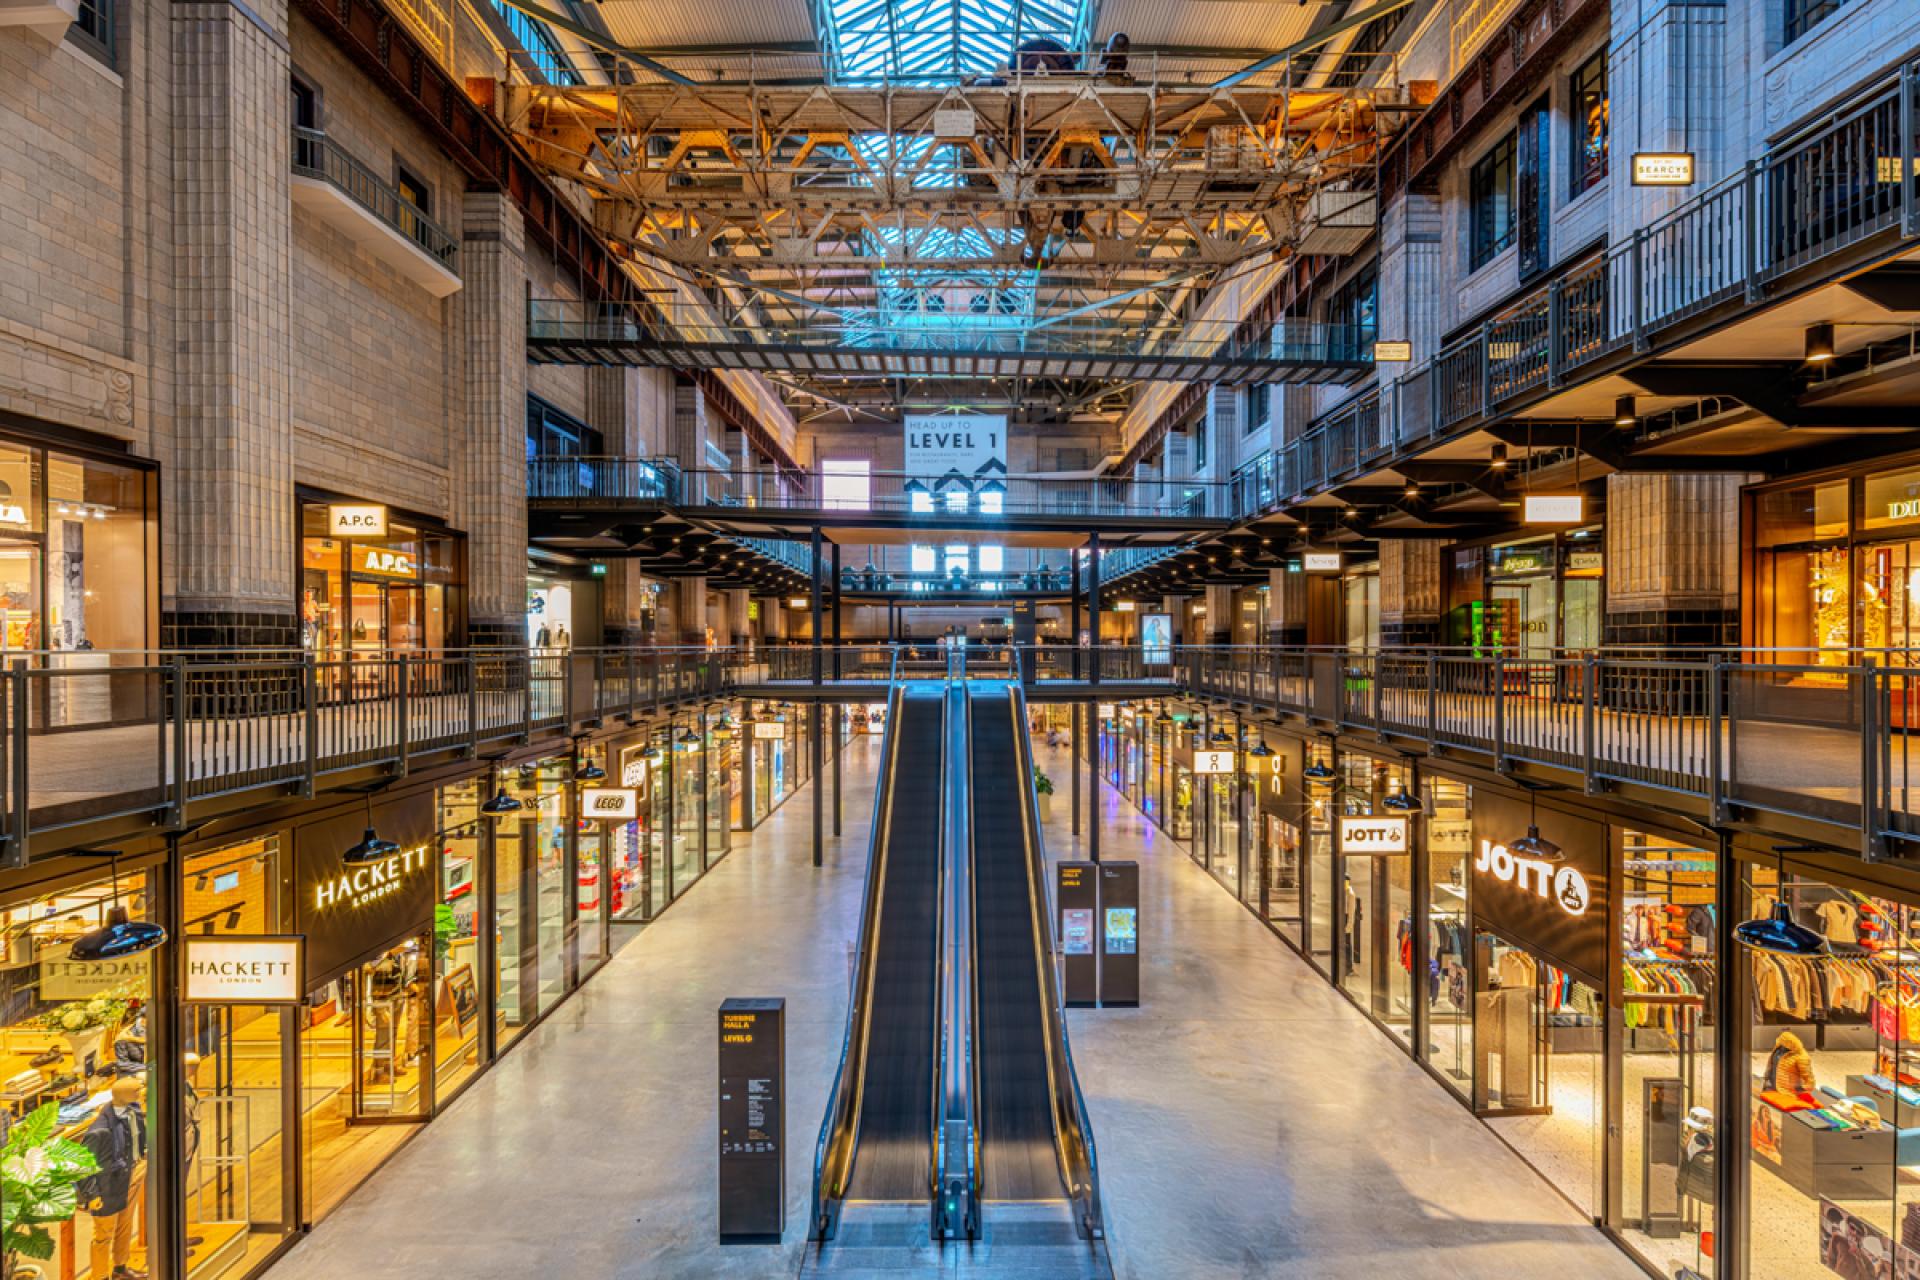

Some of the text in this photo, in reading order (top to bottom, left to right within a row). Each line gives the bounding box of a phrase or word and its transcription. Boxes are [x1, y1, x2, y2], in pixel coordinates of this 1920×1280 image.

[910, 432, 996, 448] LEVEL 1
[339, 515, 377, 526] A.P.C.
[366, 552, 411, 574] A.P.C.
[594, 796, 625, 810] LEGO
[1345, 829, 1386, 841] JOTT
[1476, 840, 1554, 897] JOTT
[317, 845, 428, 909] HACKETT
[353, 879, 400, 907] LONDON
[191, 961, 290, 976] HACKETT
